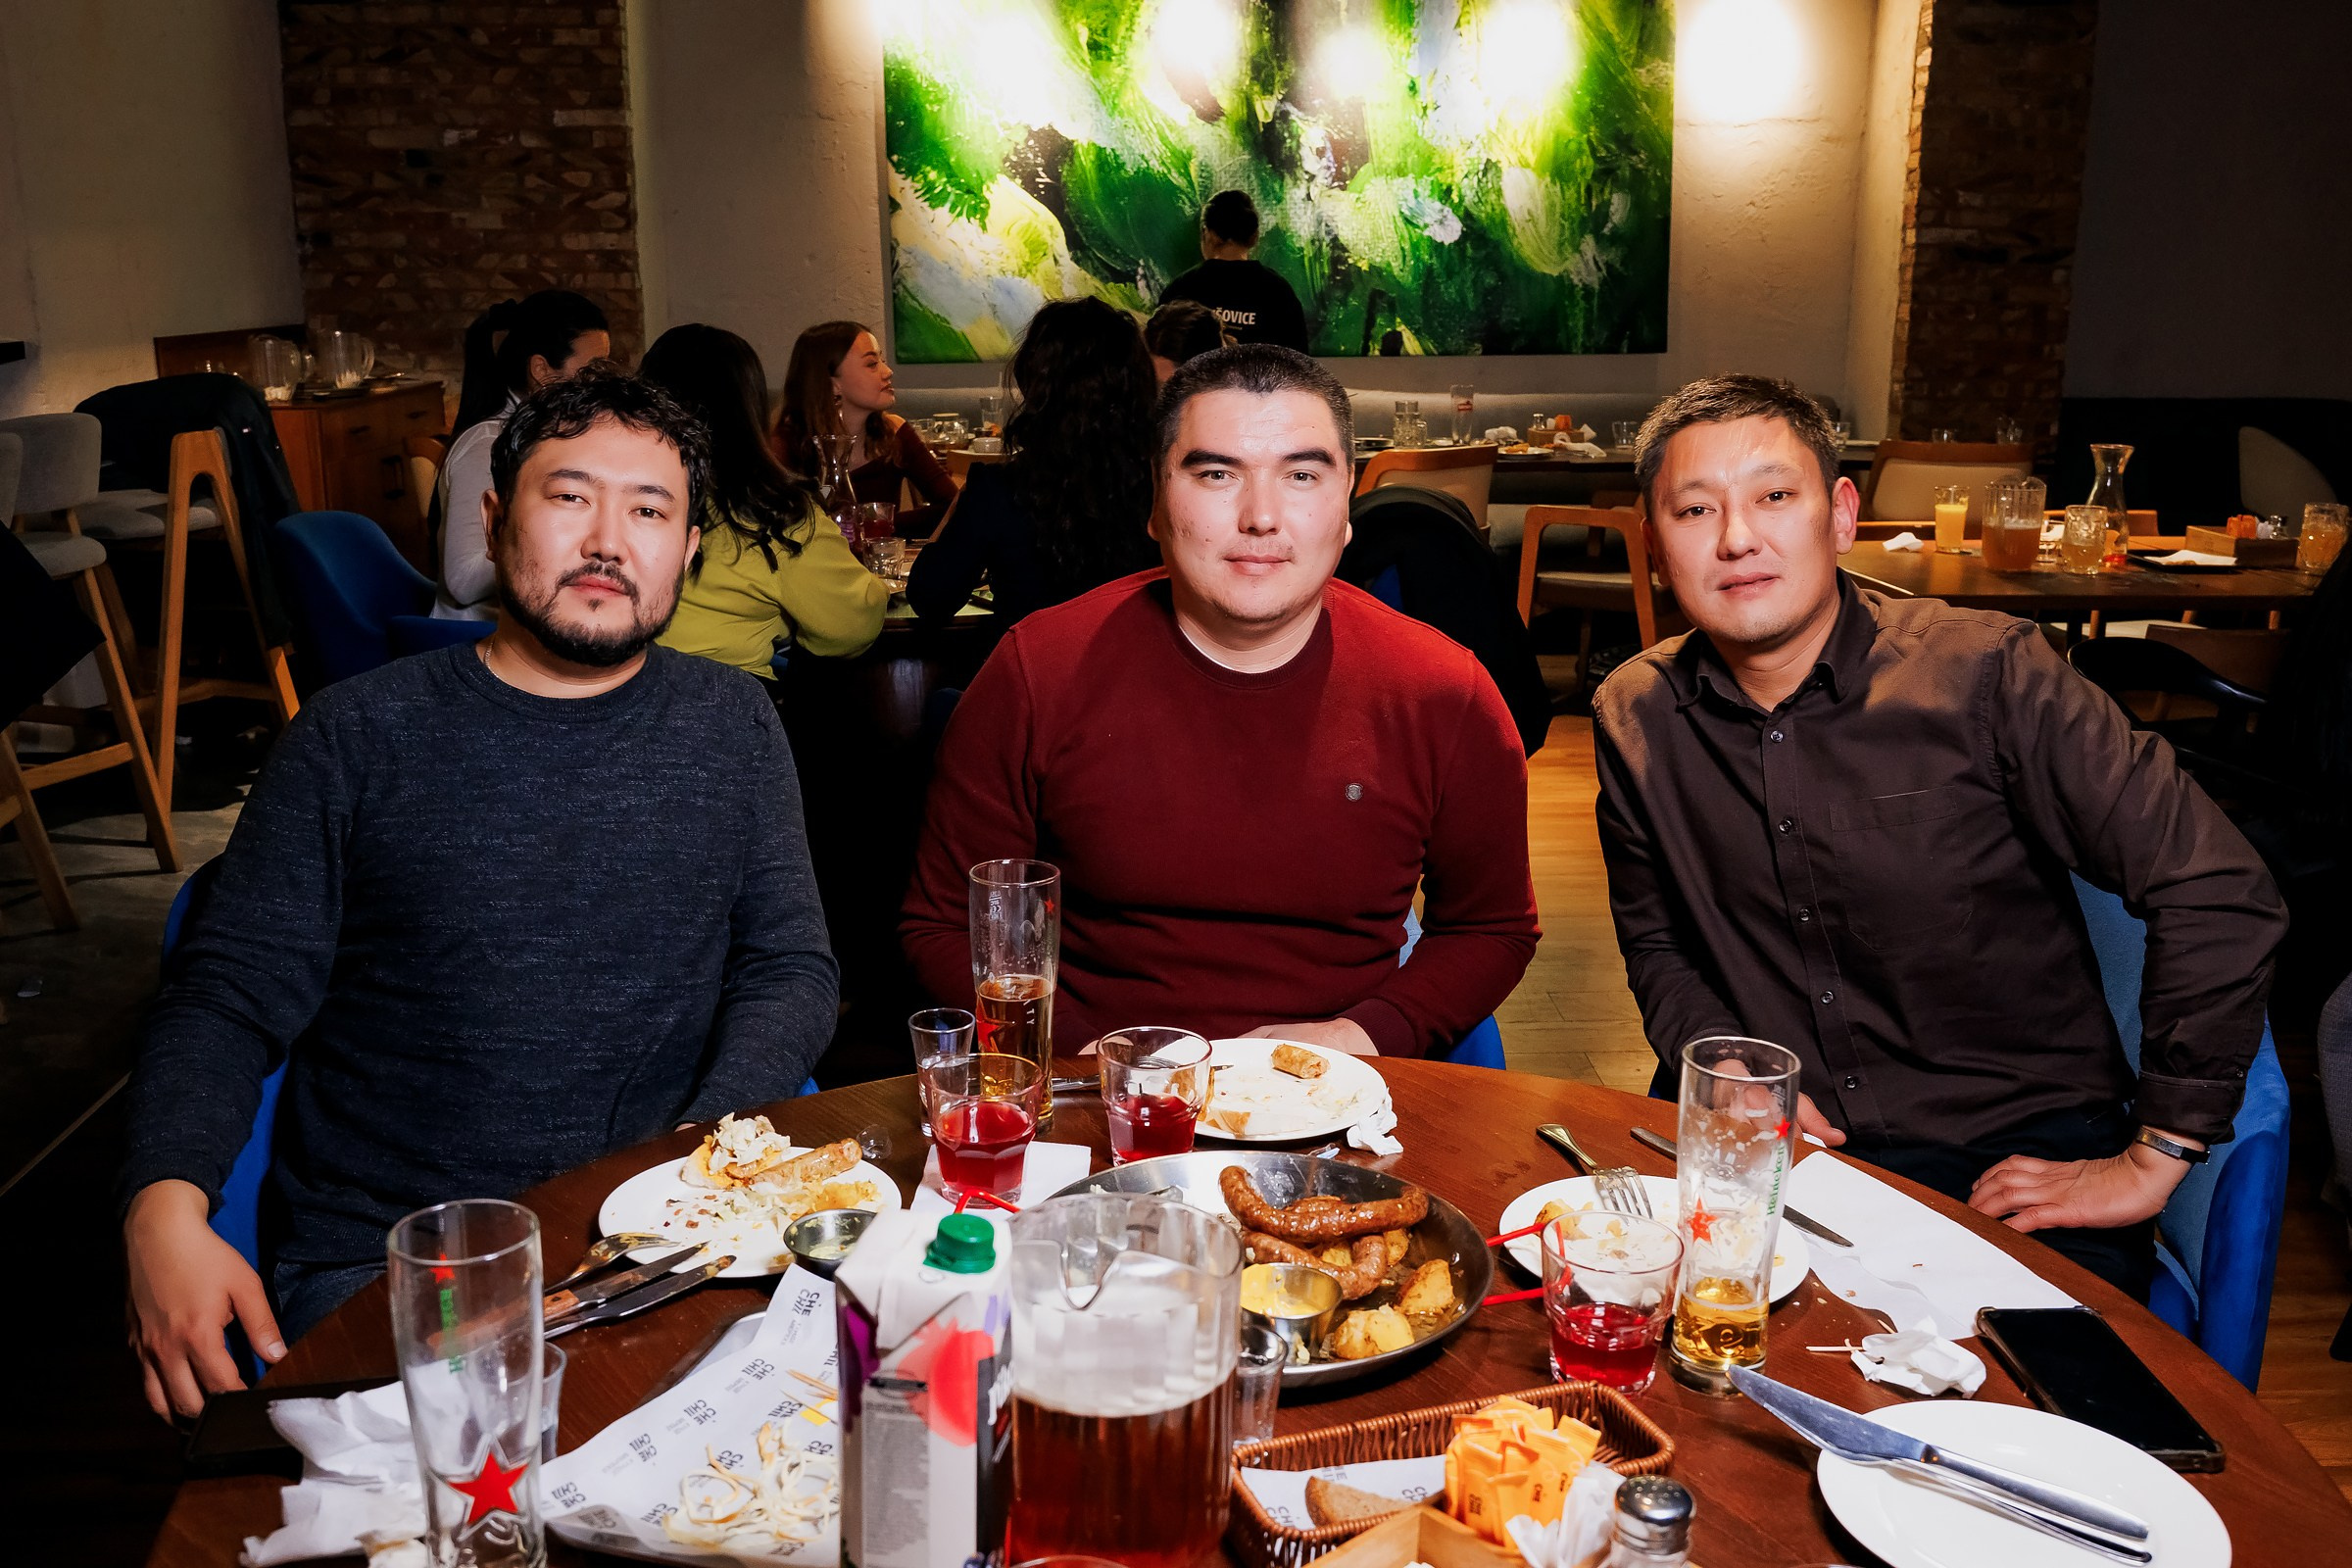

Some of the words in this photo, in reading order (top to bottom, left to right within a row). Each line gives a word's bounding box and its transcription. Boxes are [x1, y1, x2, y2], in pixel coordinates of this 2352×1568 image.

[1213, 307, 1256, 325] ŠOVICE
[1767, 1144, 1786, 1216] Heineken
[802, 1292, 820, 1316] CHE
[753, 1363, 775, 1381] CHE
[693, 1407, 717, 1426] CHE
[638, 1446, 658, 1463] CHE
